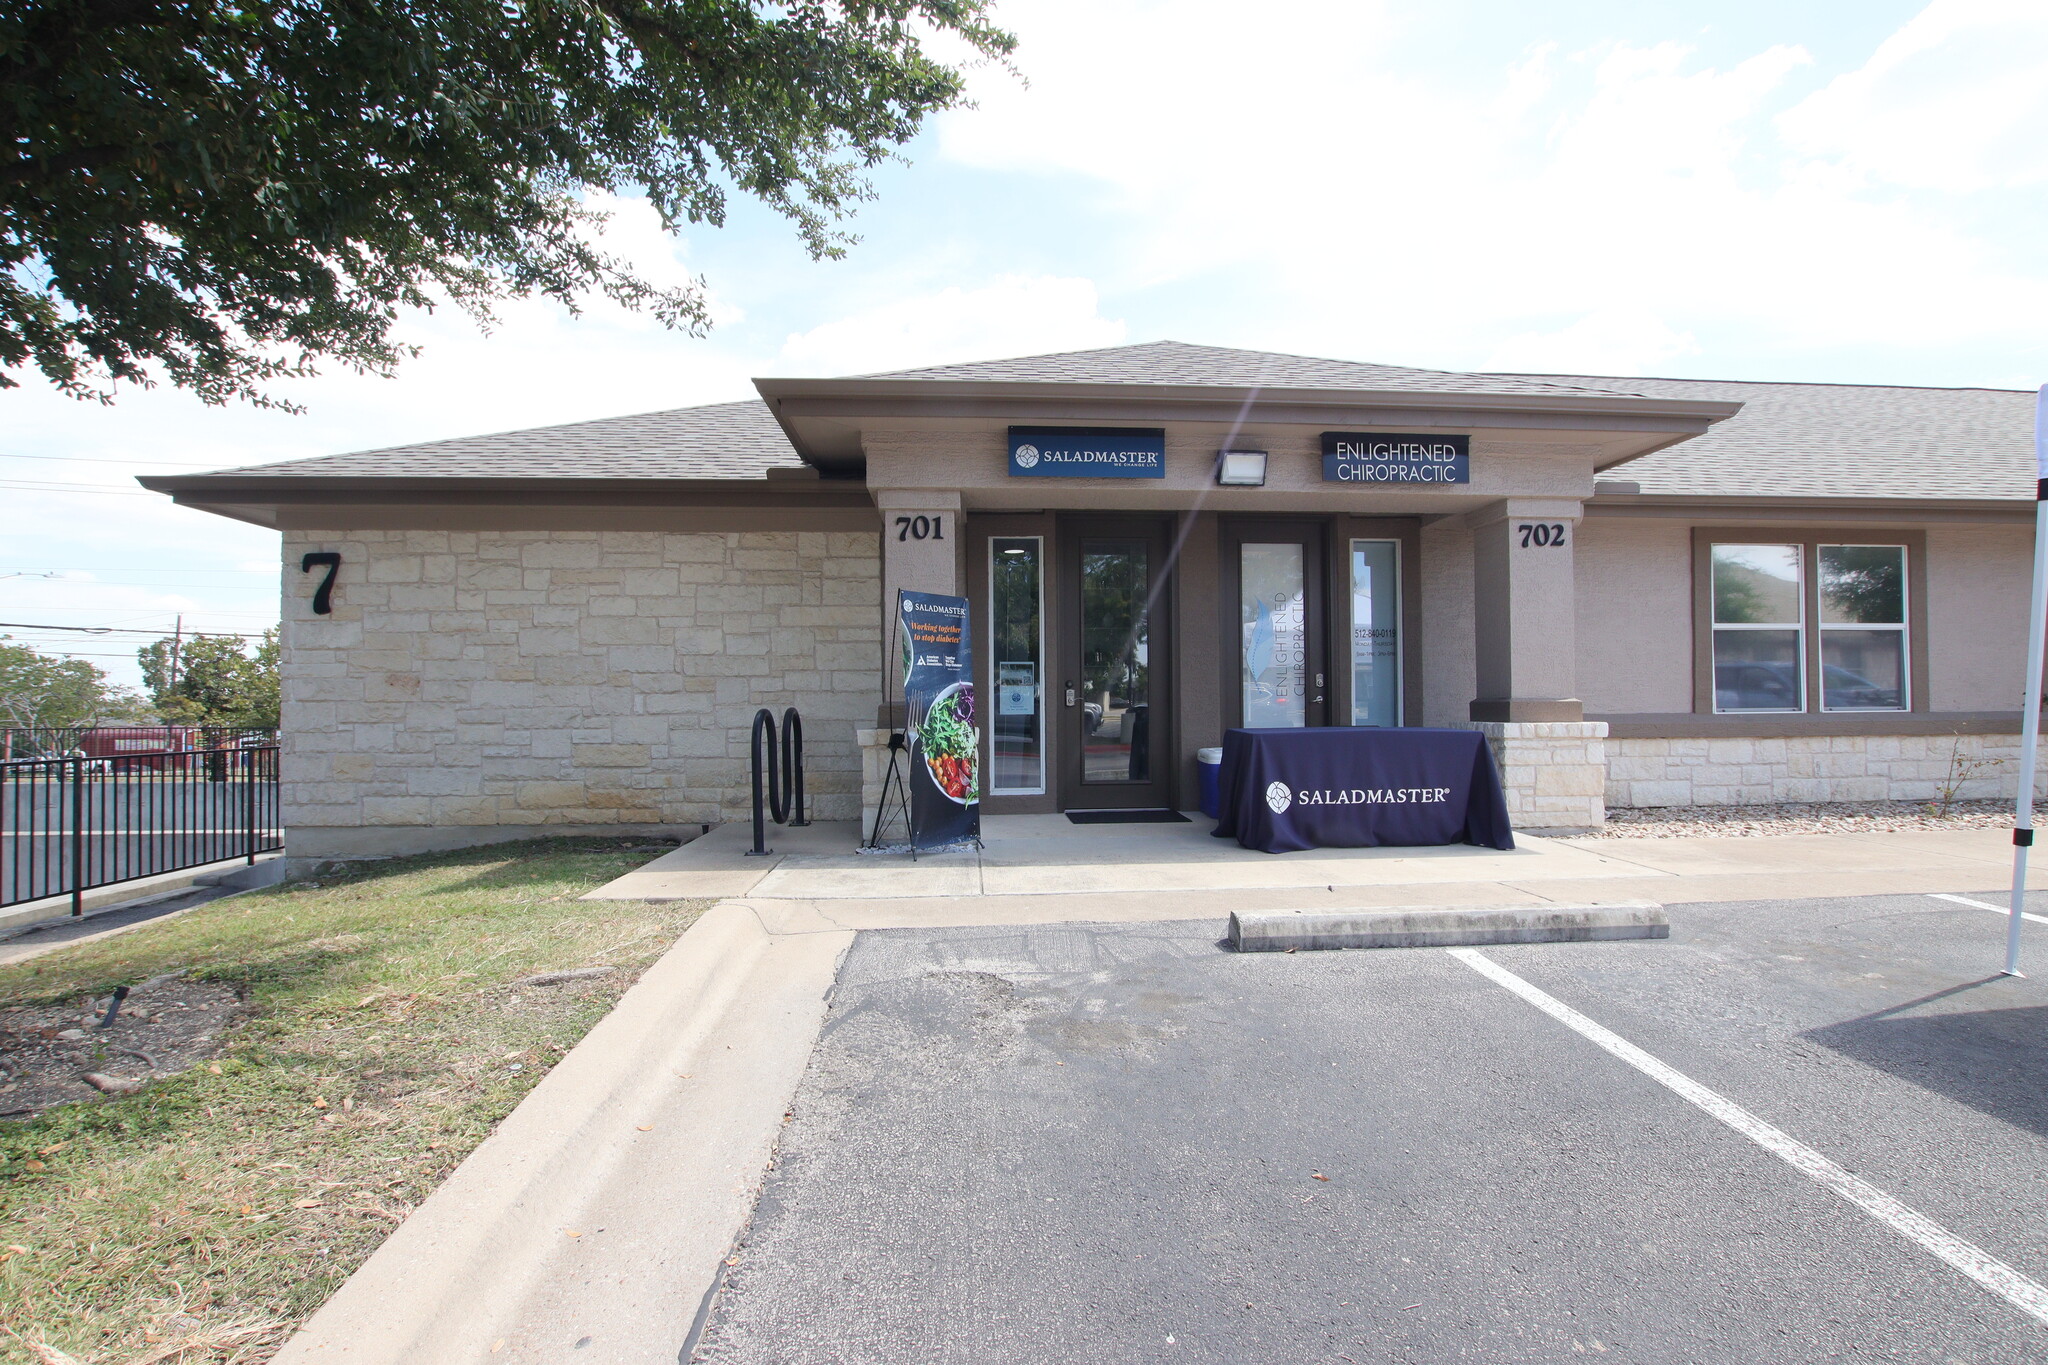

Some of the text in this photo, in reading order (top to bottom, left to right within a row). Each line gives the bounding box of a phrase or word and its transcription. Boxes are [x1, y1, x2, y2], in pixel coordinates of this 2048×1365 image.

[1336, 442, 1456, 462] ENLIGHTENED
[1337, 463, 1456, 481] CHIROPRACTIC
[895, 515, 944, 542] 701
[1518, 523, 1566, 548] 702
[302, 552, 341, 615] 7
[911, 622, 961, 633] Working together
[914, 633, 921, 641] to
[921, 634, 935, 643] stop
[1274, 592, 1288, 697] ENLIGHTENED
[1291, 593, 1305, 697] CHIROPRACTIC
